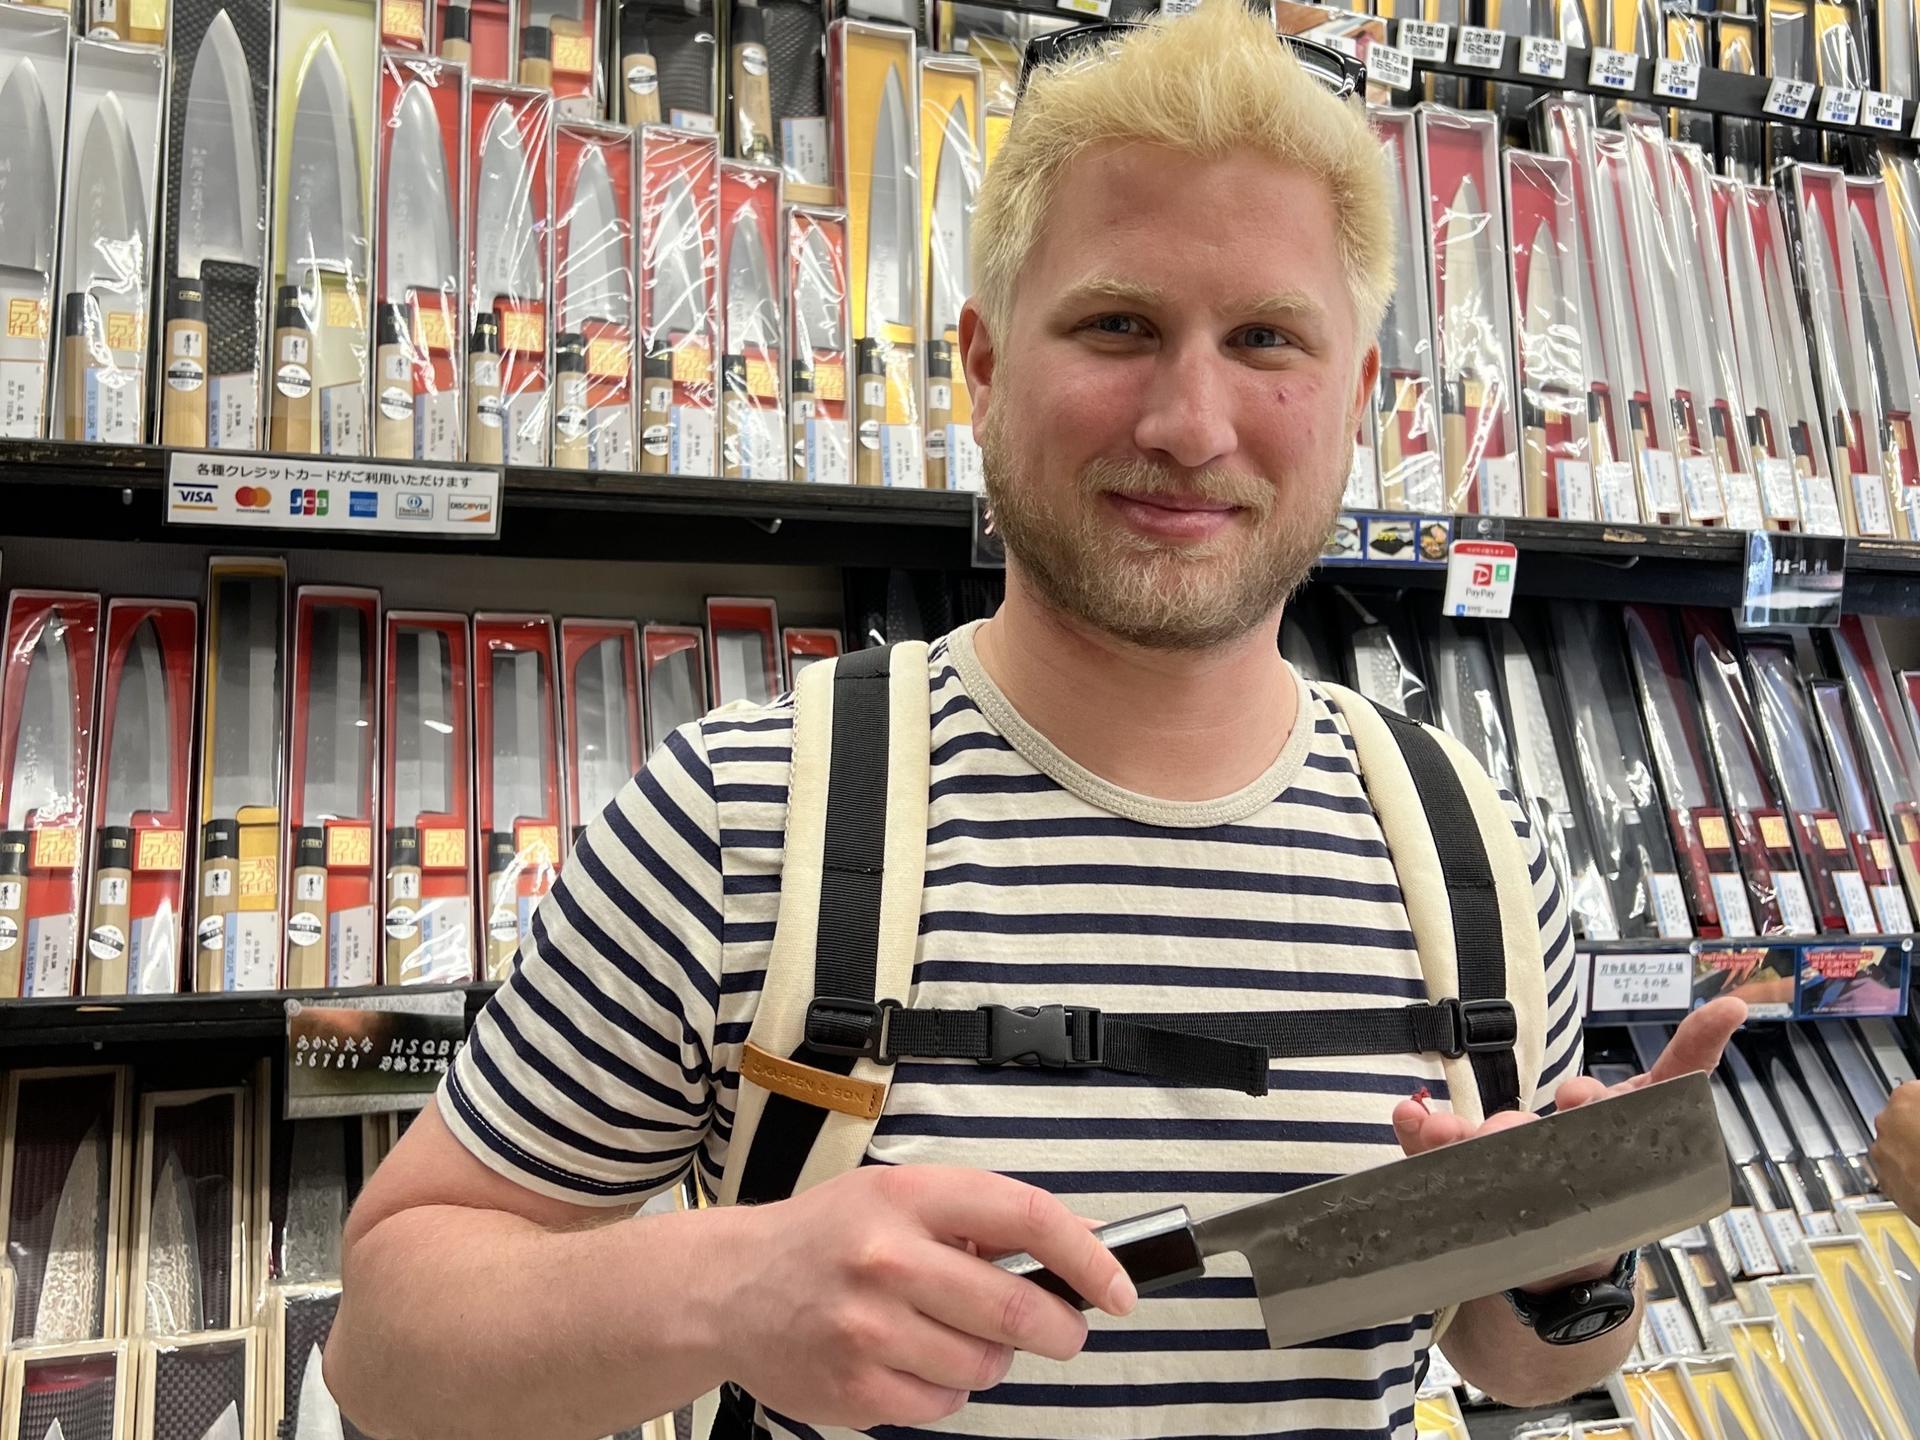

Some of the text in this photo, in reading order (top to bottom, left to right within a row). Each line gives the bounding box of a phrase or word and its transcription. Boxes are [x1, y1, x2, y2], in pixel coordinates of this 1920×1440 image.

[1404, 35, 1444, 49] 165mm
[1463, 43, 1500, 56] 165mm
[1371, 57, 1409, 77] 165mm
[1596, 64, 1633, 76] 240mm
[1661, 73, 1696, 86] 210mm
[1773, 93, 1807, 107] 210mm
[1826, 102, 1856, 114] 210mm
[1868, 106, 1900, 119] 180mm
[196, 463, 473, 488] 各種クレジットカードがご利用いただけます
[180, 490, 213, 503] VISA
[450, 501, 488, 511] DISCOVER
[1466, 588, 1495, 599] PayPay
[297, 1035, 373, 1053] あかさたな
[295, 1052, 359, 1069] 56789
[832, 1088, 864, 1103] SON
